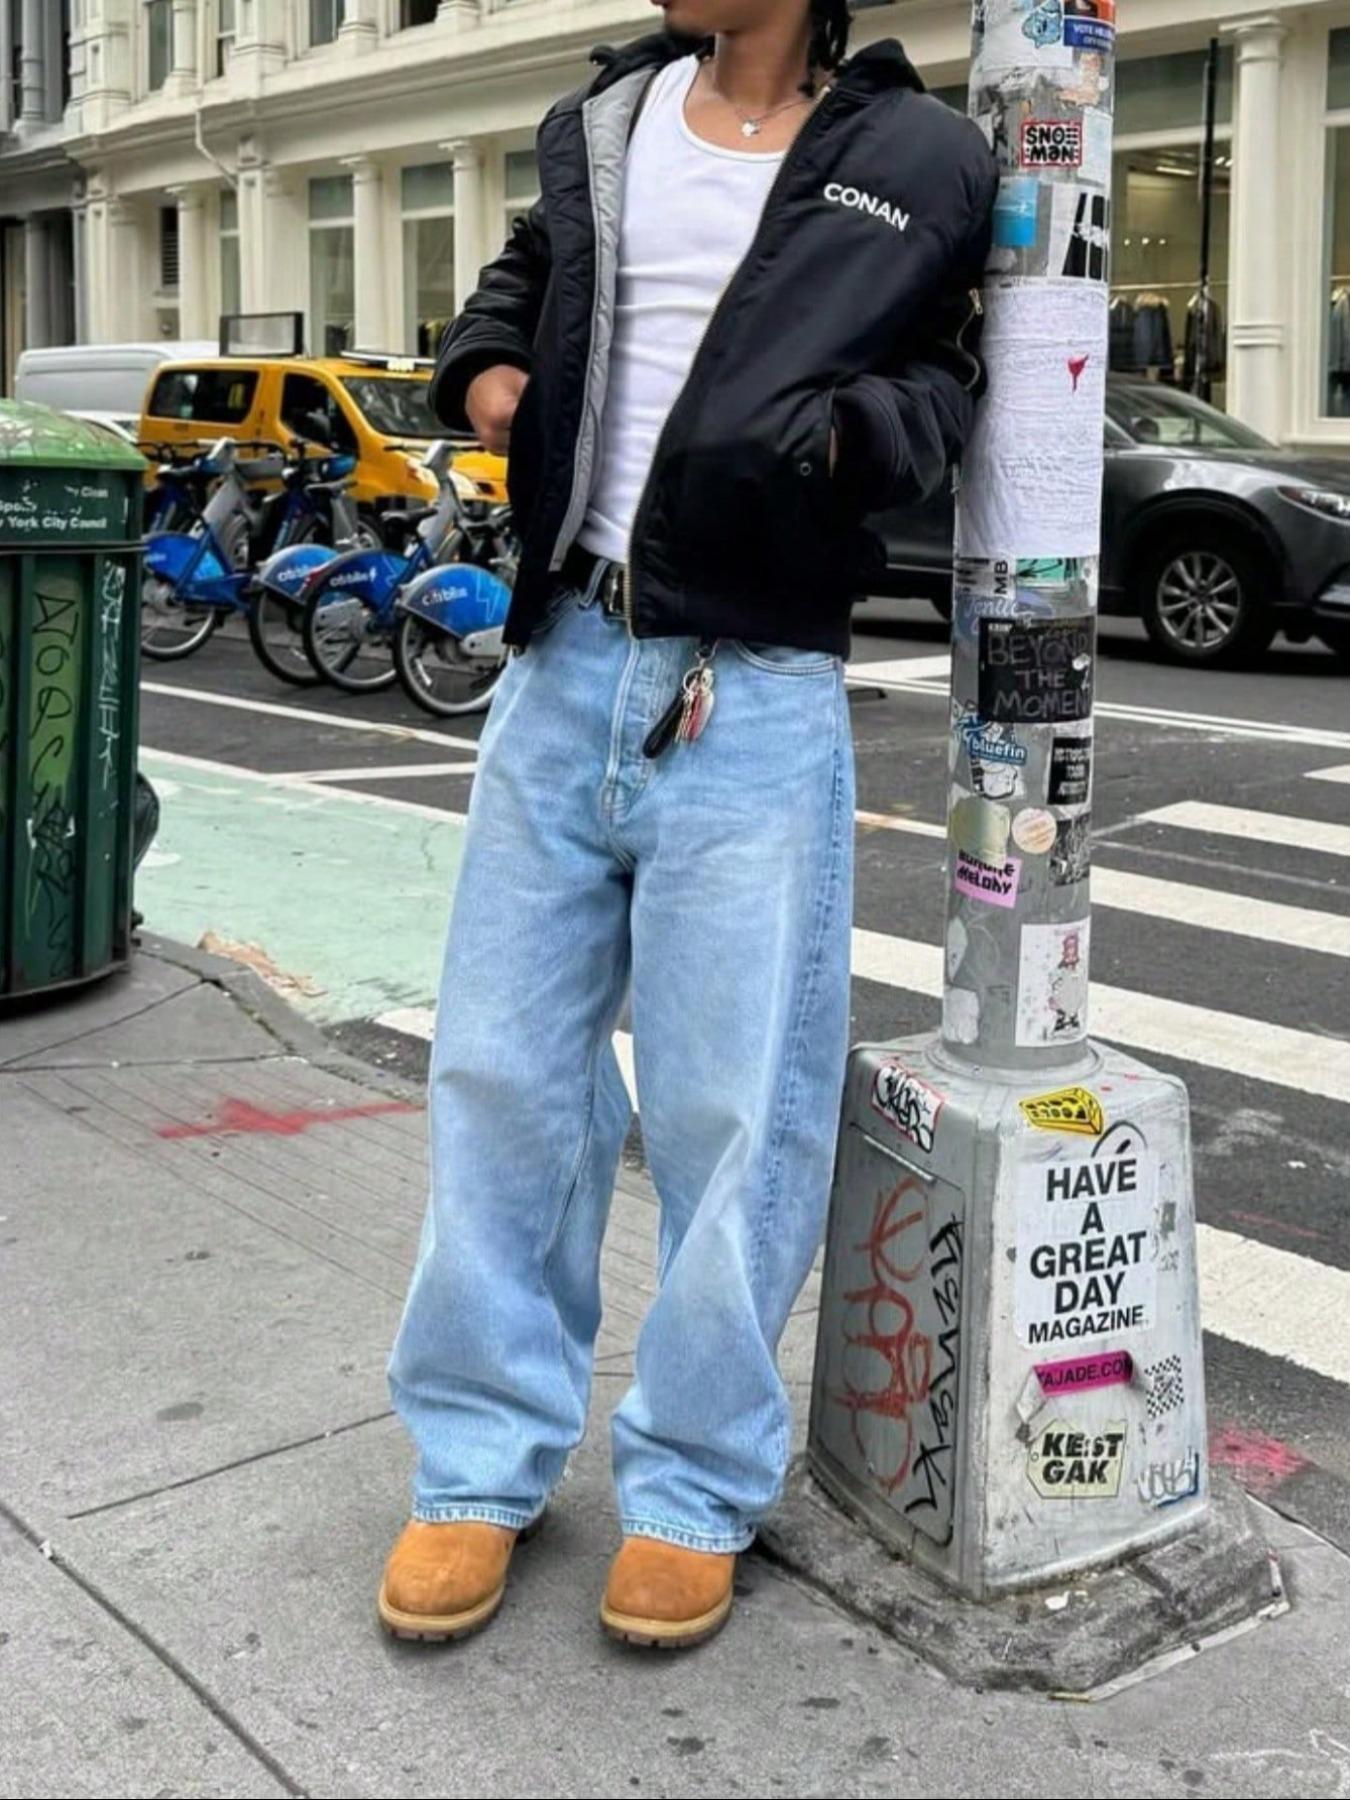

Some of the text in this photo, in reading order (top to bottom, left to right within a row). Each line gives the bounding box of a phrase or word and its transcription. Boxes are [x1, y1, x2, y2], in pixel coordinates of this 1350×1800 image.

[823, 182, 910, 232] CONAN
[7, 516, 39, 529] York
[41, 517, 67, 531] City
[987, 632, 1088, 666] BEYOND
[1014, 669, 1067, 690] THE
[972, 735, 1024, 759] bluefin
[1046, 1159, 1137, 1202] HAVE
[1080, 1202, 1105, 1235] A
[1029, 1231, 1147, 1279] GREAT
[1054, 1271, 1125, 1315] DAY
[1028, 1305, 1144, 1344] MAGAZINE
[1043, 1460, 1109, 1485] GAK
